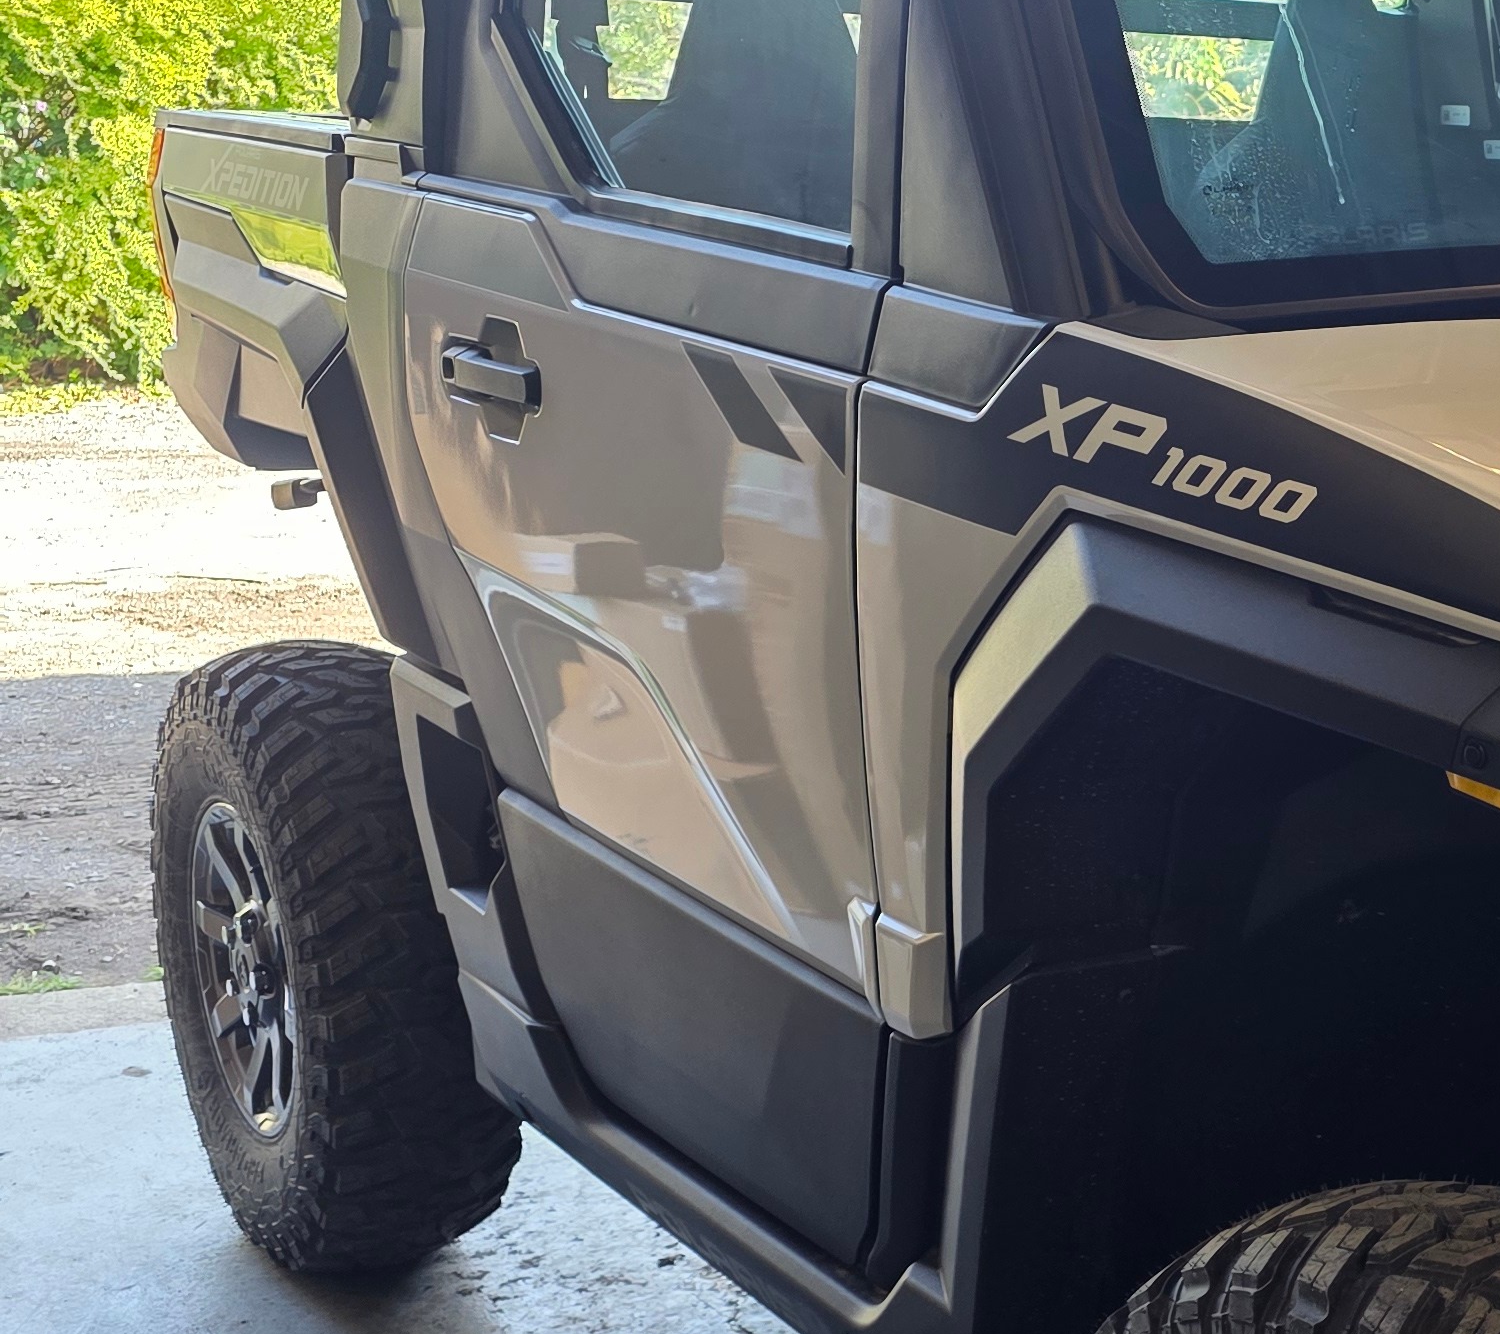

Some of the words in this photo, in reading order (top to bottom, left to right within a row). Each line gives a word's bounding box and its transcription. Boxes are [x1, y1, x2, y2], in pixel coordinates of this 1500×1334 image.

[199, 143, 310, 212] XPEDITION
[1006, 384, 1168, 465] XP
[1151, 447, 1319, 524] 1000
